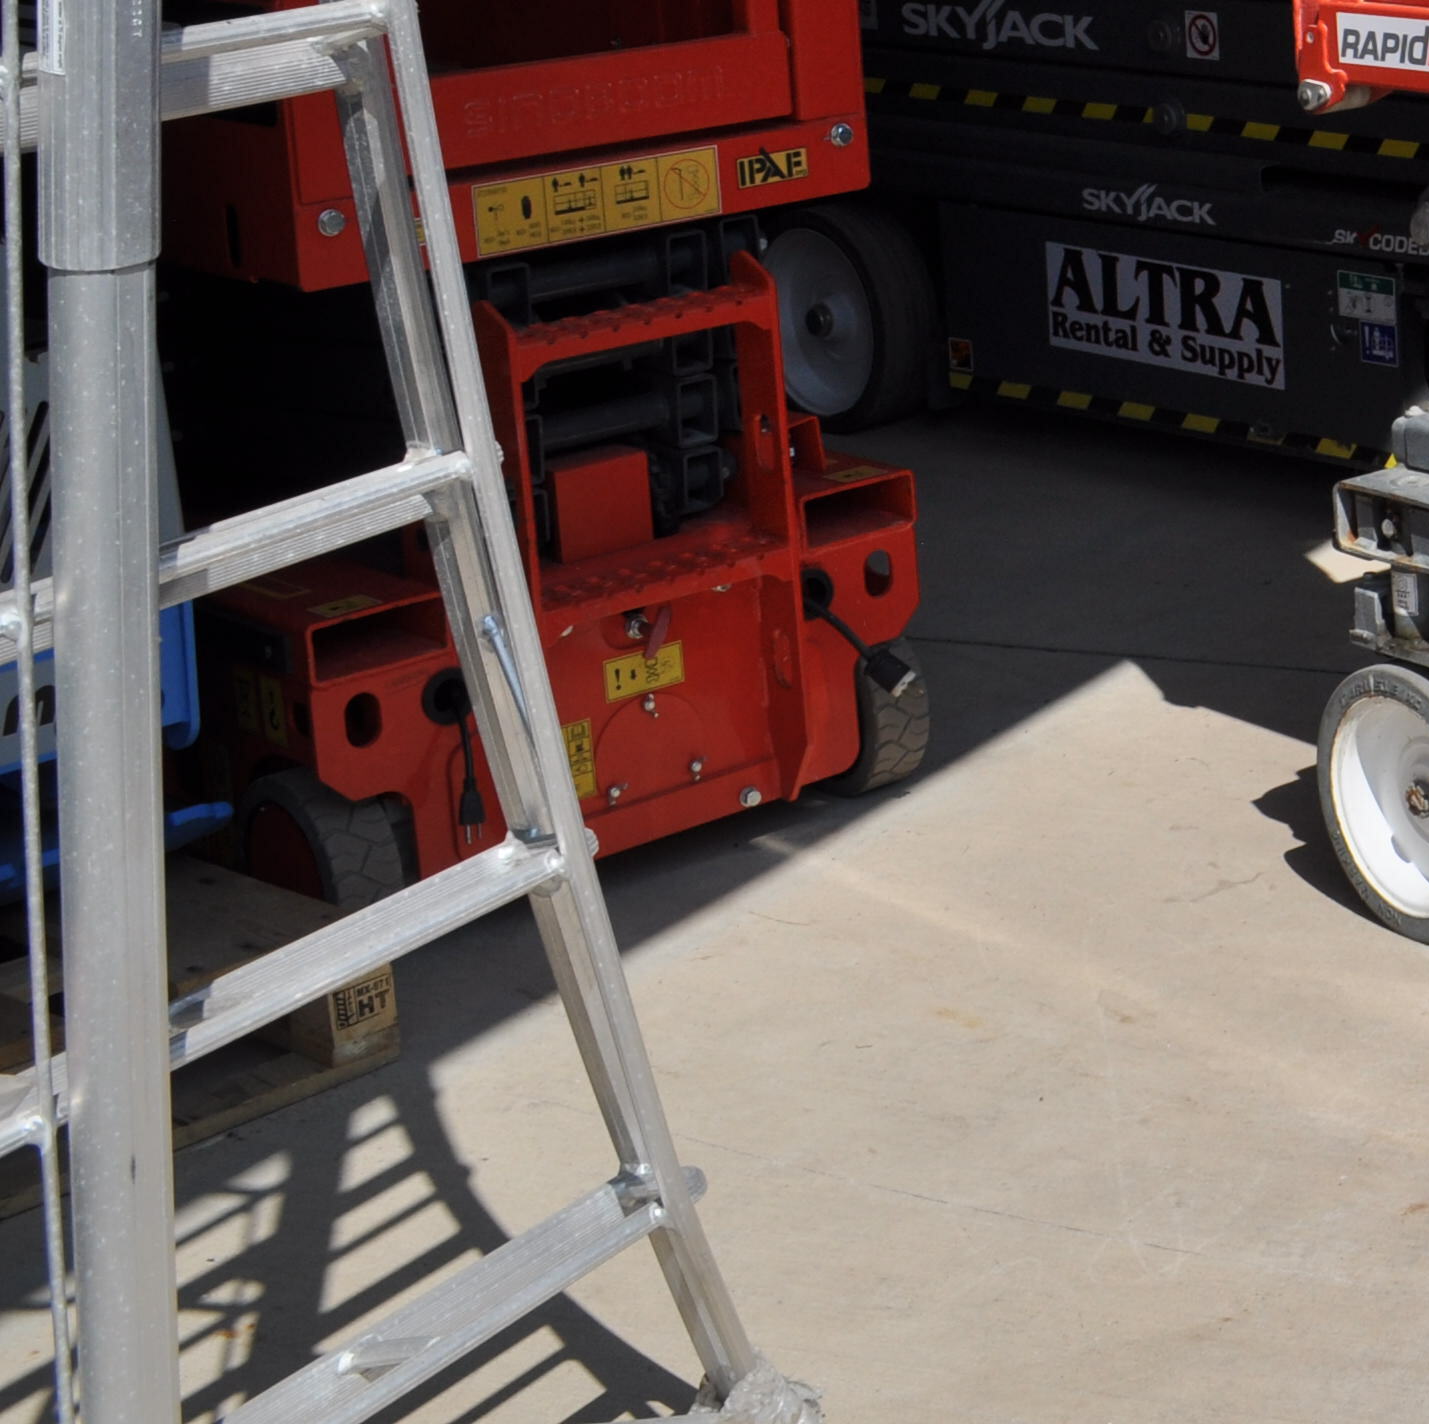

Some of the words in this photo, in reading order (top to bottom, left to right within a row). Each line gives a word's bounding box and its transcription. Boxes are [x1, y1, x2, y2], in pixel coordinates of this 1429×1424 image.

[1082, 183, 1216, 226] SKYJACK
[1049, 246, 1280, 349] ALTRA
[1052, 312, 1139, 354] Rental
[1148, 329, 1172, 357] &
[1181, 330, 1281, 386] Supply
[358, 988, 390, 1018] HT
